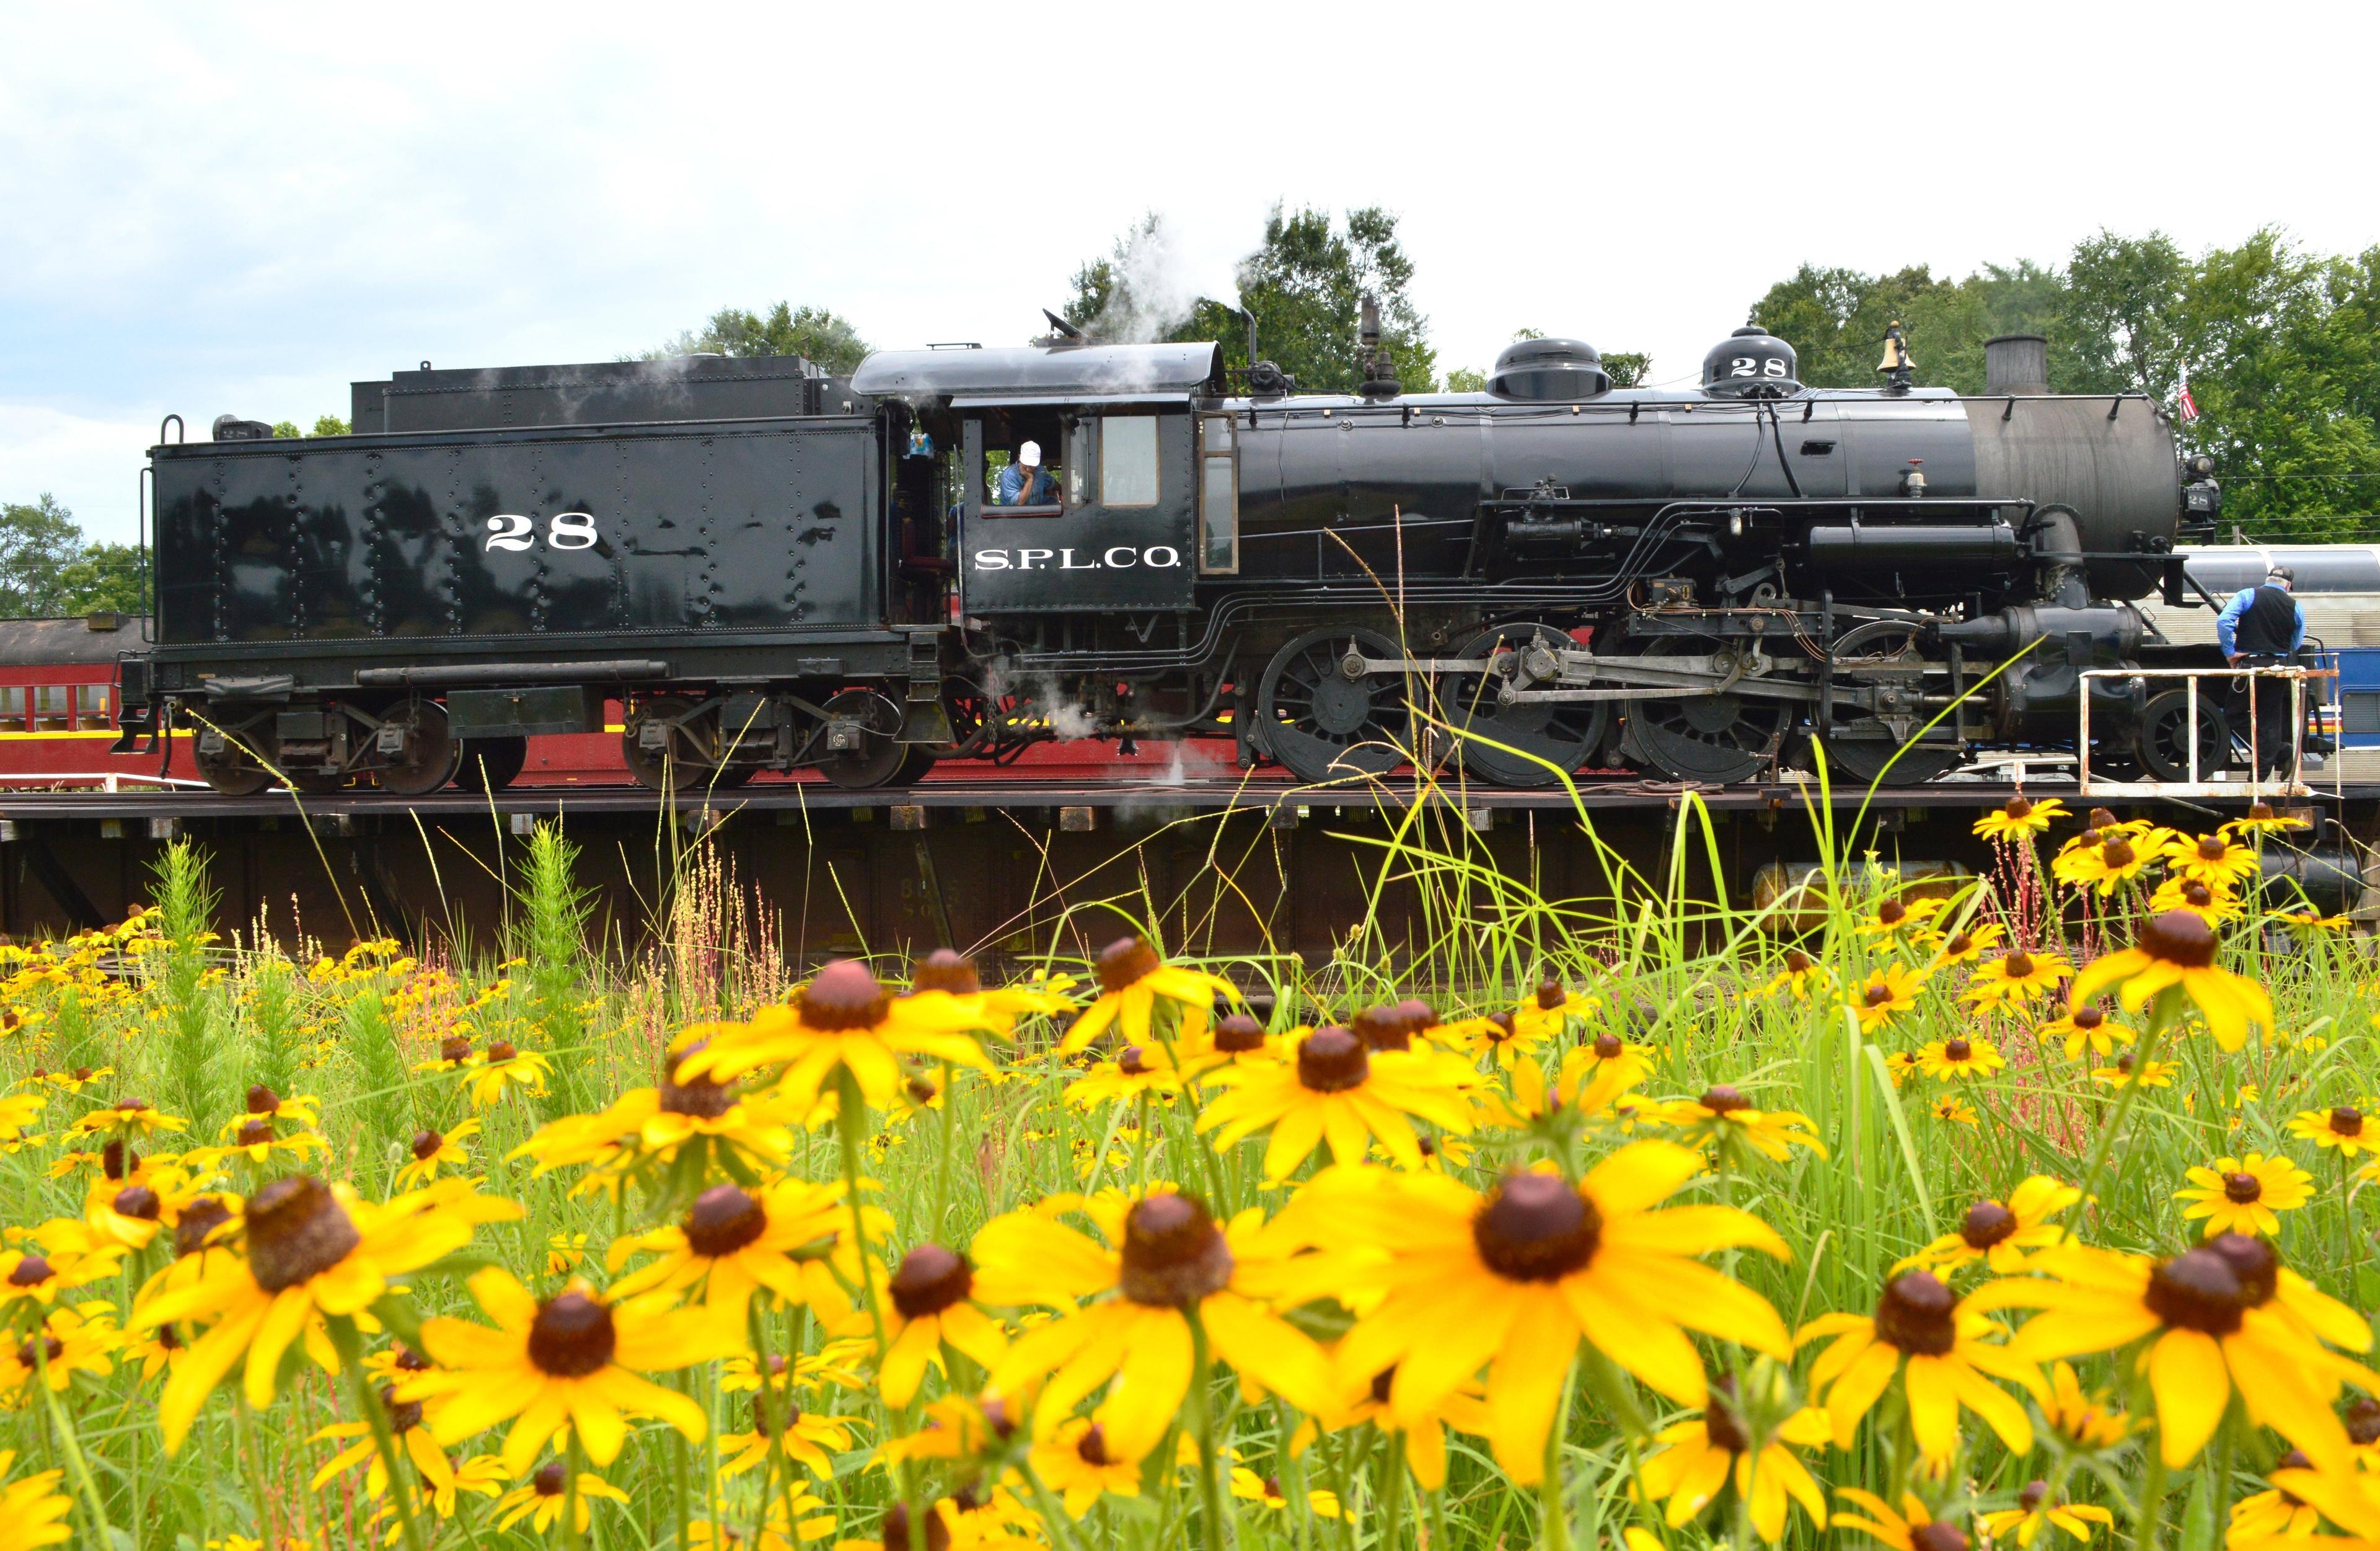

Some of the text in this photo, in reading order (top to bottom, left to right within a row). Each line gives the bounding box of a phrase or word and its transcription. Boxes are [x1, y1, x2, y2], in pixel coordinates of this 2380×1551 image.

[1731, 358, 1787, 377] 28
[2188, 495, 2208, 505] 28
[486, 513, 597, 552] 28
